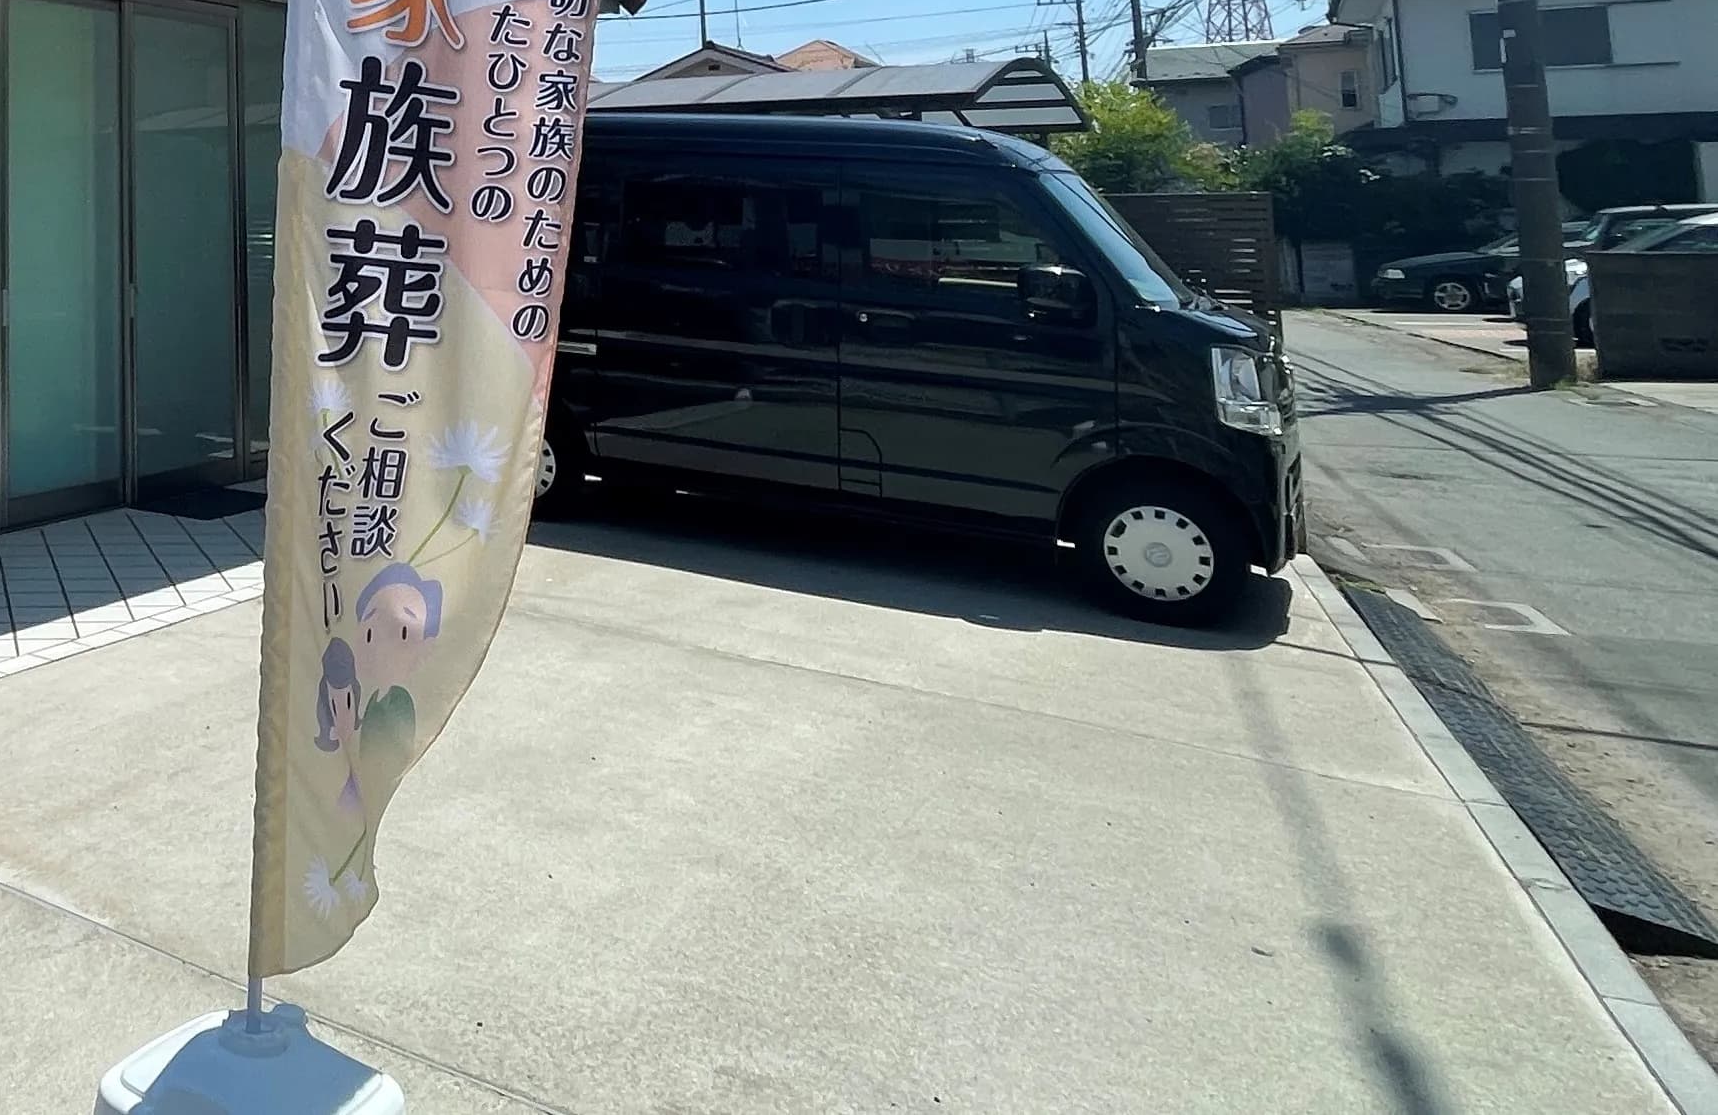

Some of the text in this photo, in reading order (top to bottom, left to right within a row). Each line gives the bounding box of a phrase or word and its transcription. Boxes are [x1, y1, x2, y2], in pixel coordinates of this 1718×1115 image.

[316, 410, 356, 632] ください
[350, 389, 421, 559] ご相談
